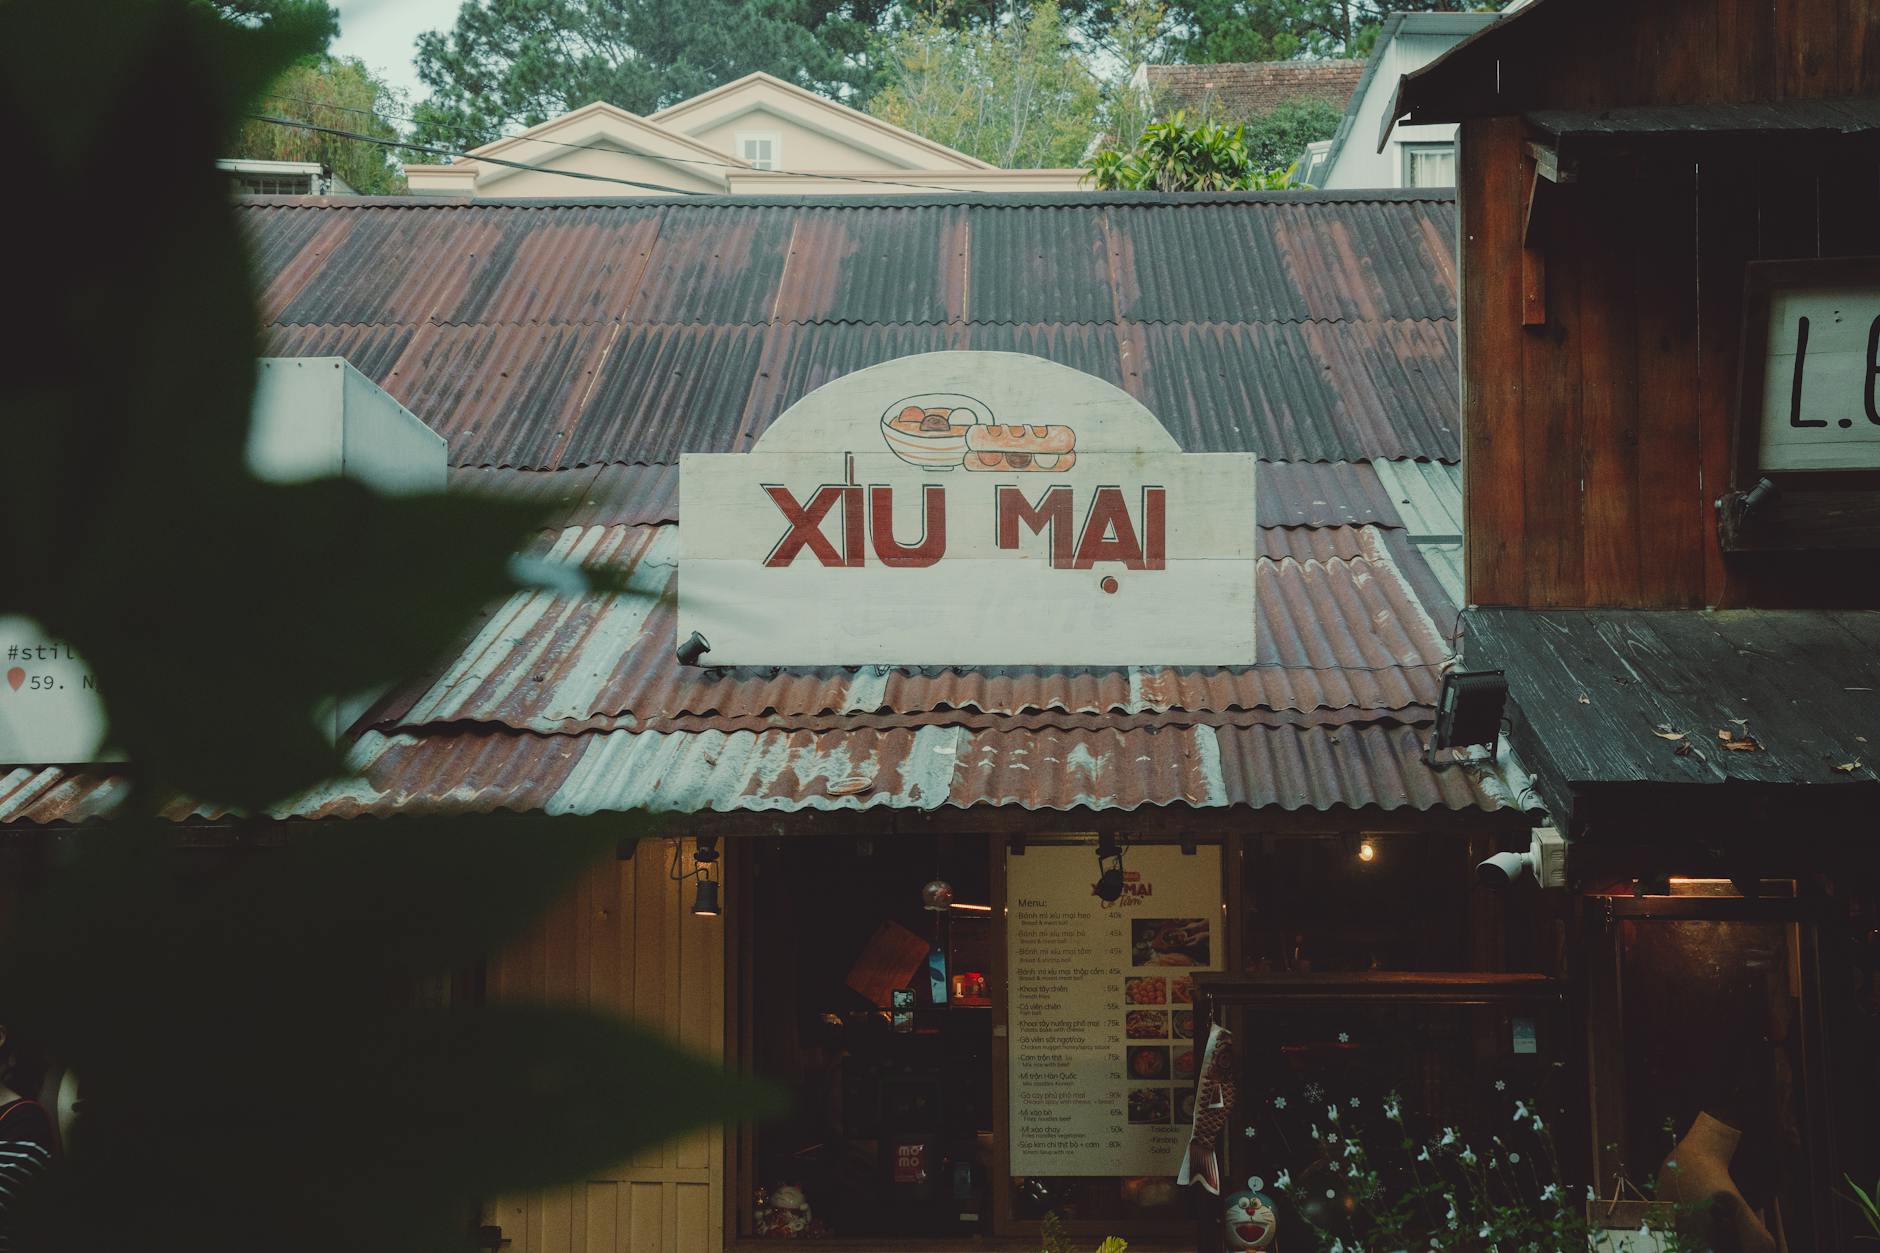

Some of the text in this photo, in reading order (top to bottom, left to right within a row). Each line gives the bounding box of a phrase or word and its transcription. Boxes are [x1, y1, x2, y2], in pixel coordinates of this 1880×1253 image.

[995, 484, 1167, 595] MẠI
[8, 643, 75, 660] #stil
[30, 676, 64, 690] 59.
